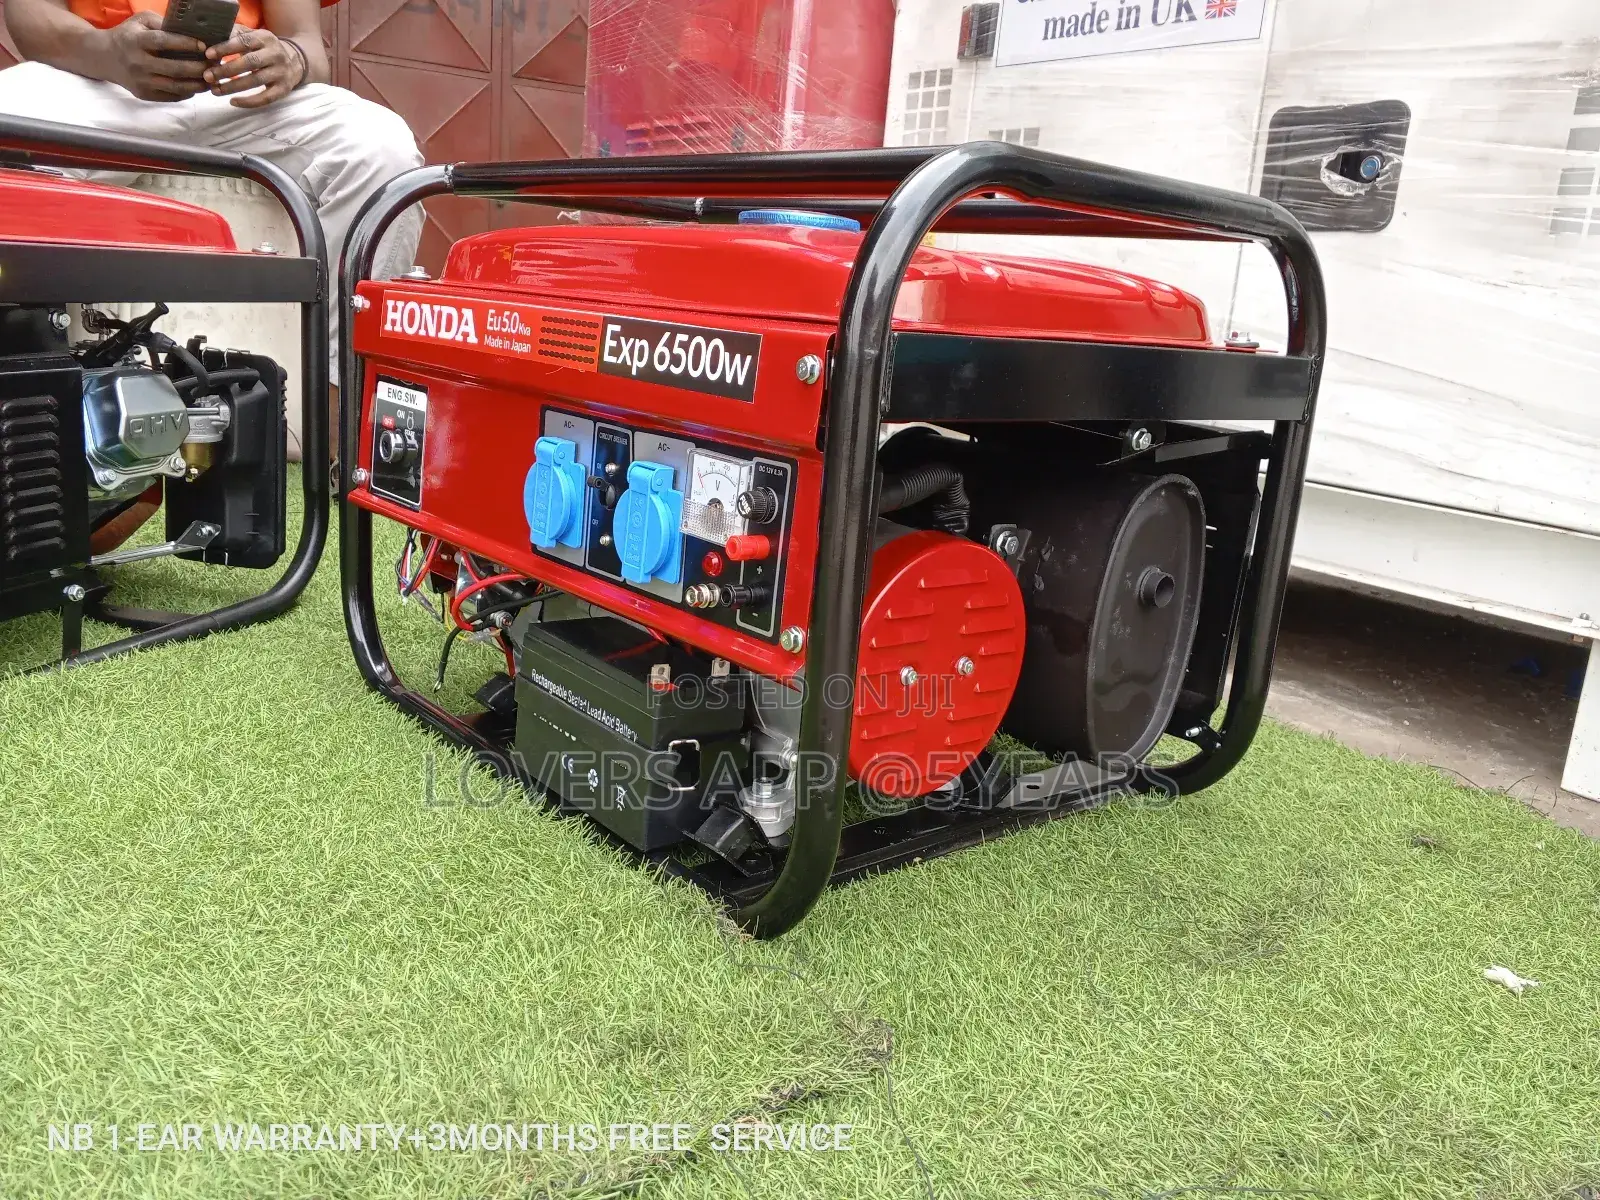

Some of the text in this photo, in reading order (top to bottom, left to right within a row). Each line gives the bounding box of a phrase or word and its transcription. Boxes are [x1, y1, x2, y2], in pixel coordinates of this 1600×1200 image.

[1042, 0, 1198, 41] made in UK
[383, 299, 478, 344] HONDA
[484, 334, 531, 354] Made in Japan
[603, 323, 752, 386] Exp 6500w
[387, 387, 418, 406] ENG.SW.
[129, 412, 184, 436] OHV
[396, 409, 405, 419] ON
[758, 465, 766, 473] DC
[715, 479, 721, 491] V
[531, 668, 568, 700] Rechargeable
[586, 701, 602, 721] Lead
[601, 709, 615, 729] Acid
[615, 717, 638, 742] Battery
